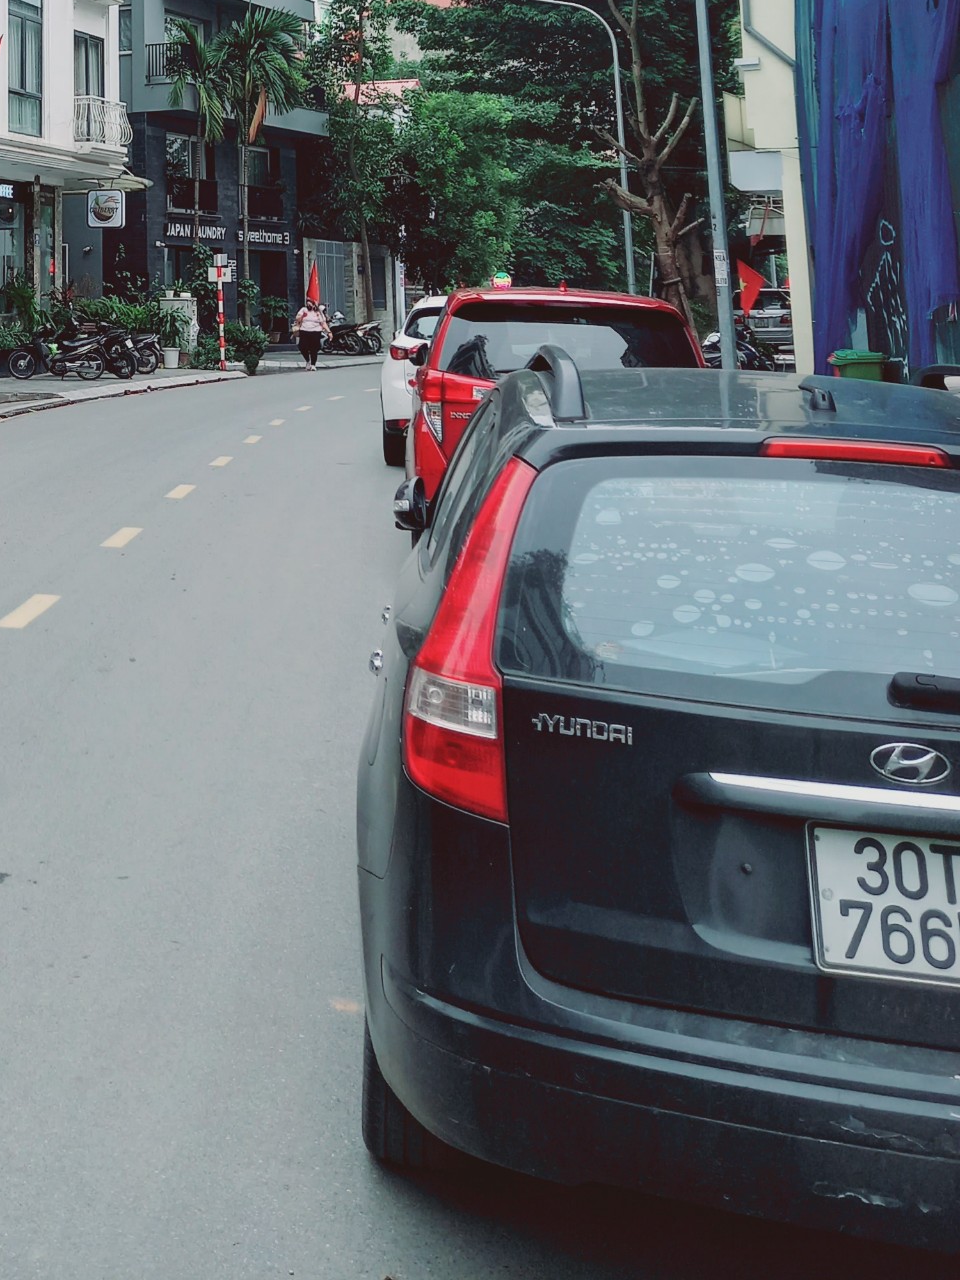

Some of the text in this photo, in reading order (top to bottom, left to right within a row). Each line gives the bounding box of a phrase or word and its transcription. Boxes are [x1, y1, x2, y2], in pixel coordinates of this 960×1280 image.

[166, 223, 191, 237] JAPAN
[283, 232, 290, 244] 3
[531, 713, 633, 746] HYUNDAI
[854, 837, 960, 905] 30T
[839, 899, 960, 970] 766
